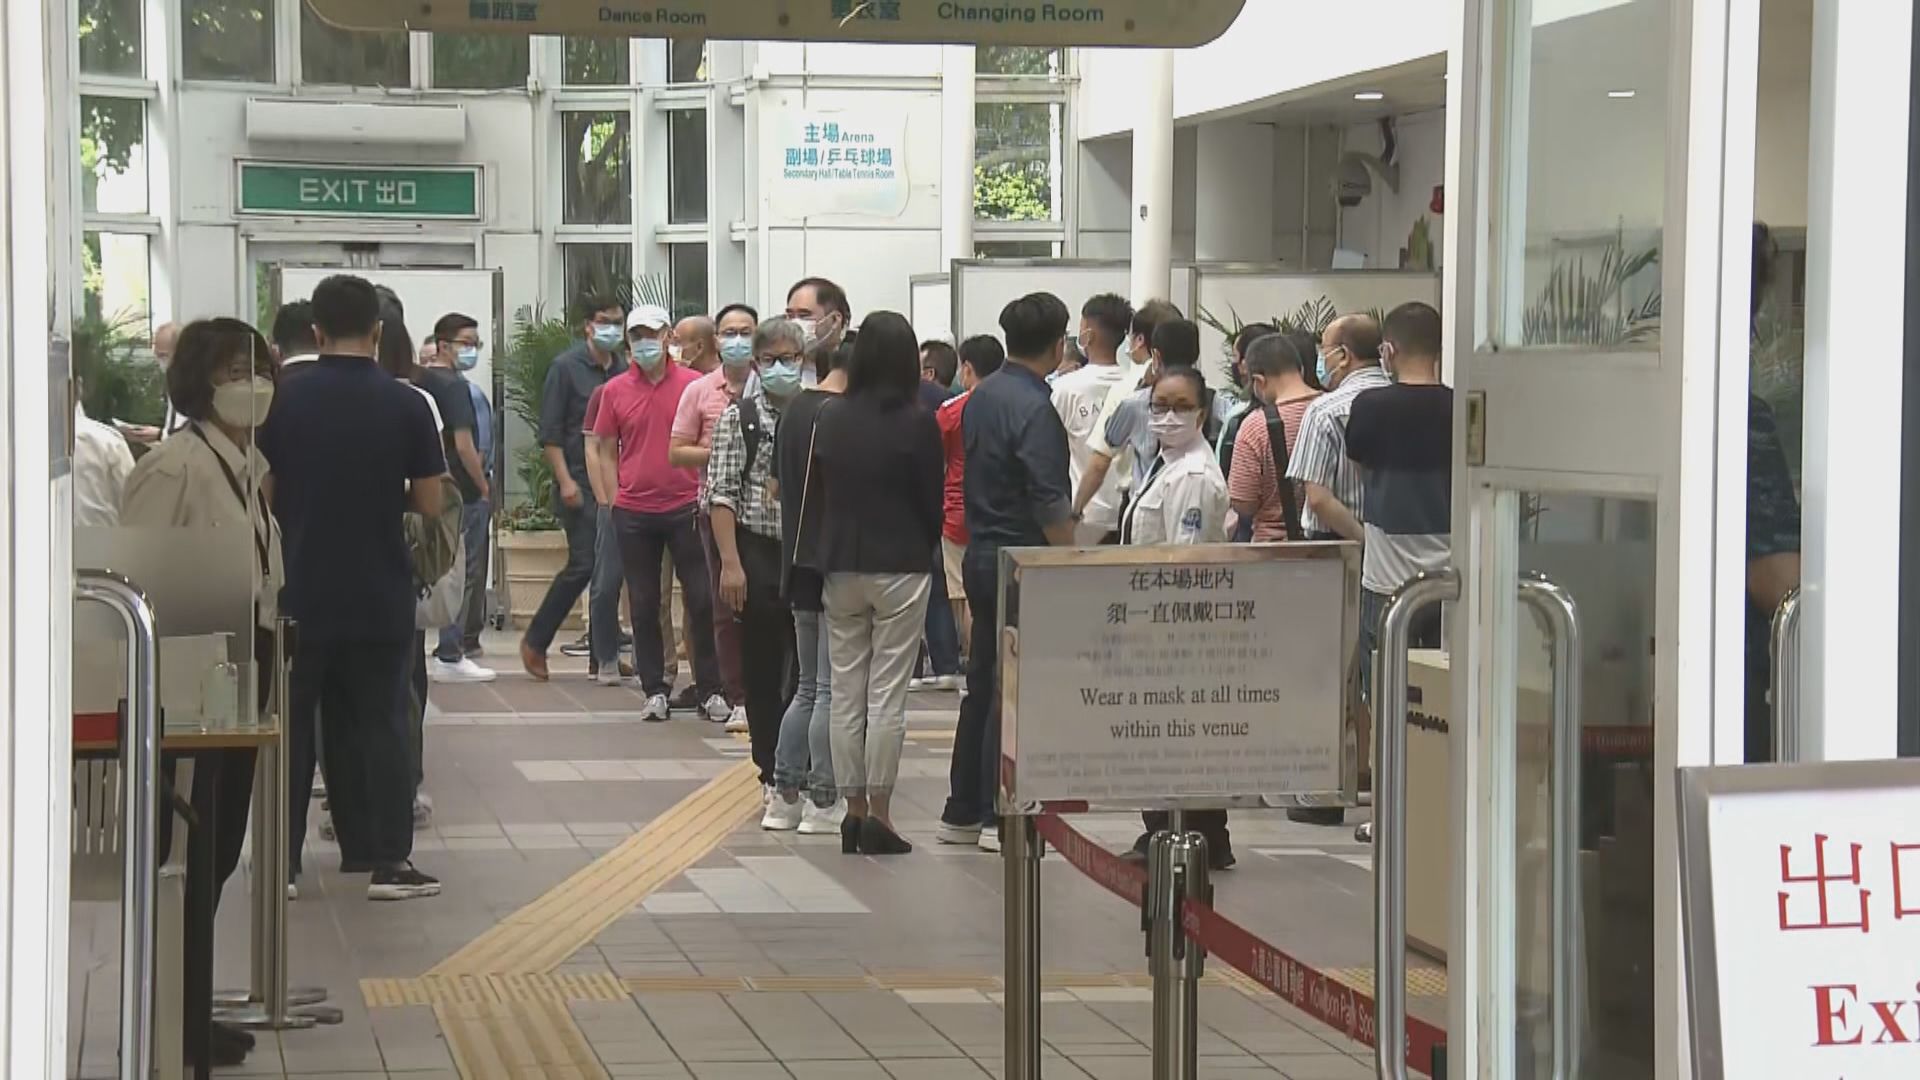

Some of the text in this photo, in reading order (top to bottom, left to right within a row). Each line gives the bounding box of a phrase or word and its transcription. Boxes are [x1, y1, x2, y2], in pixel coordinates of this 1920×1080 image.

[598, 7, 707, 24] Dance Room
[937, 2, 1104, 23] Changing Room
[804, 122, 875, 143] 主場 Arena
[783, 168, 818, 181] Secondary
[852, 168, 874, 180] Tennis
[874, 168, 895, 179] Room
[299, 178, 416, 204] EXIT 出口
[1079, 400, 1104, 417] BA
[1106, 600, 1256, 624] 須一直佩戴口罩
[1080, 685, 1280, 706] Wear a mask at all times
[1110, 718, 1250, 739] within this venue
